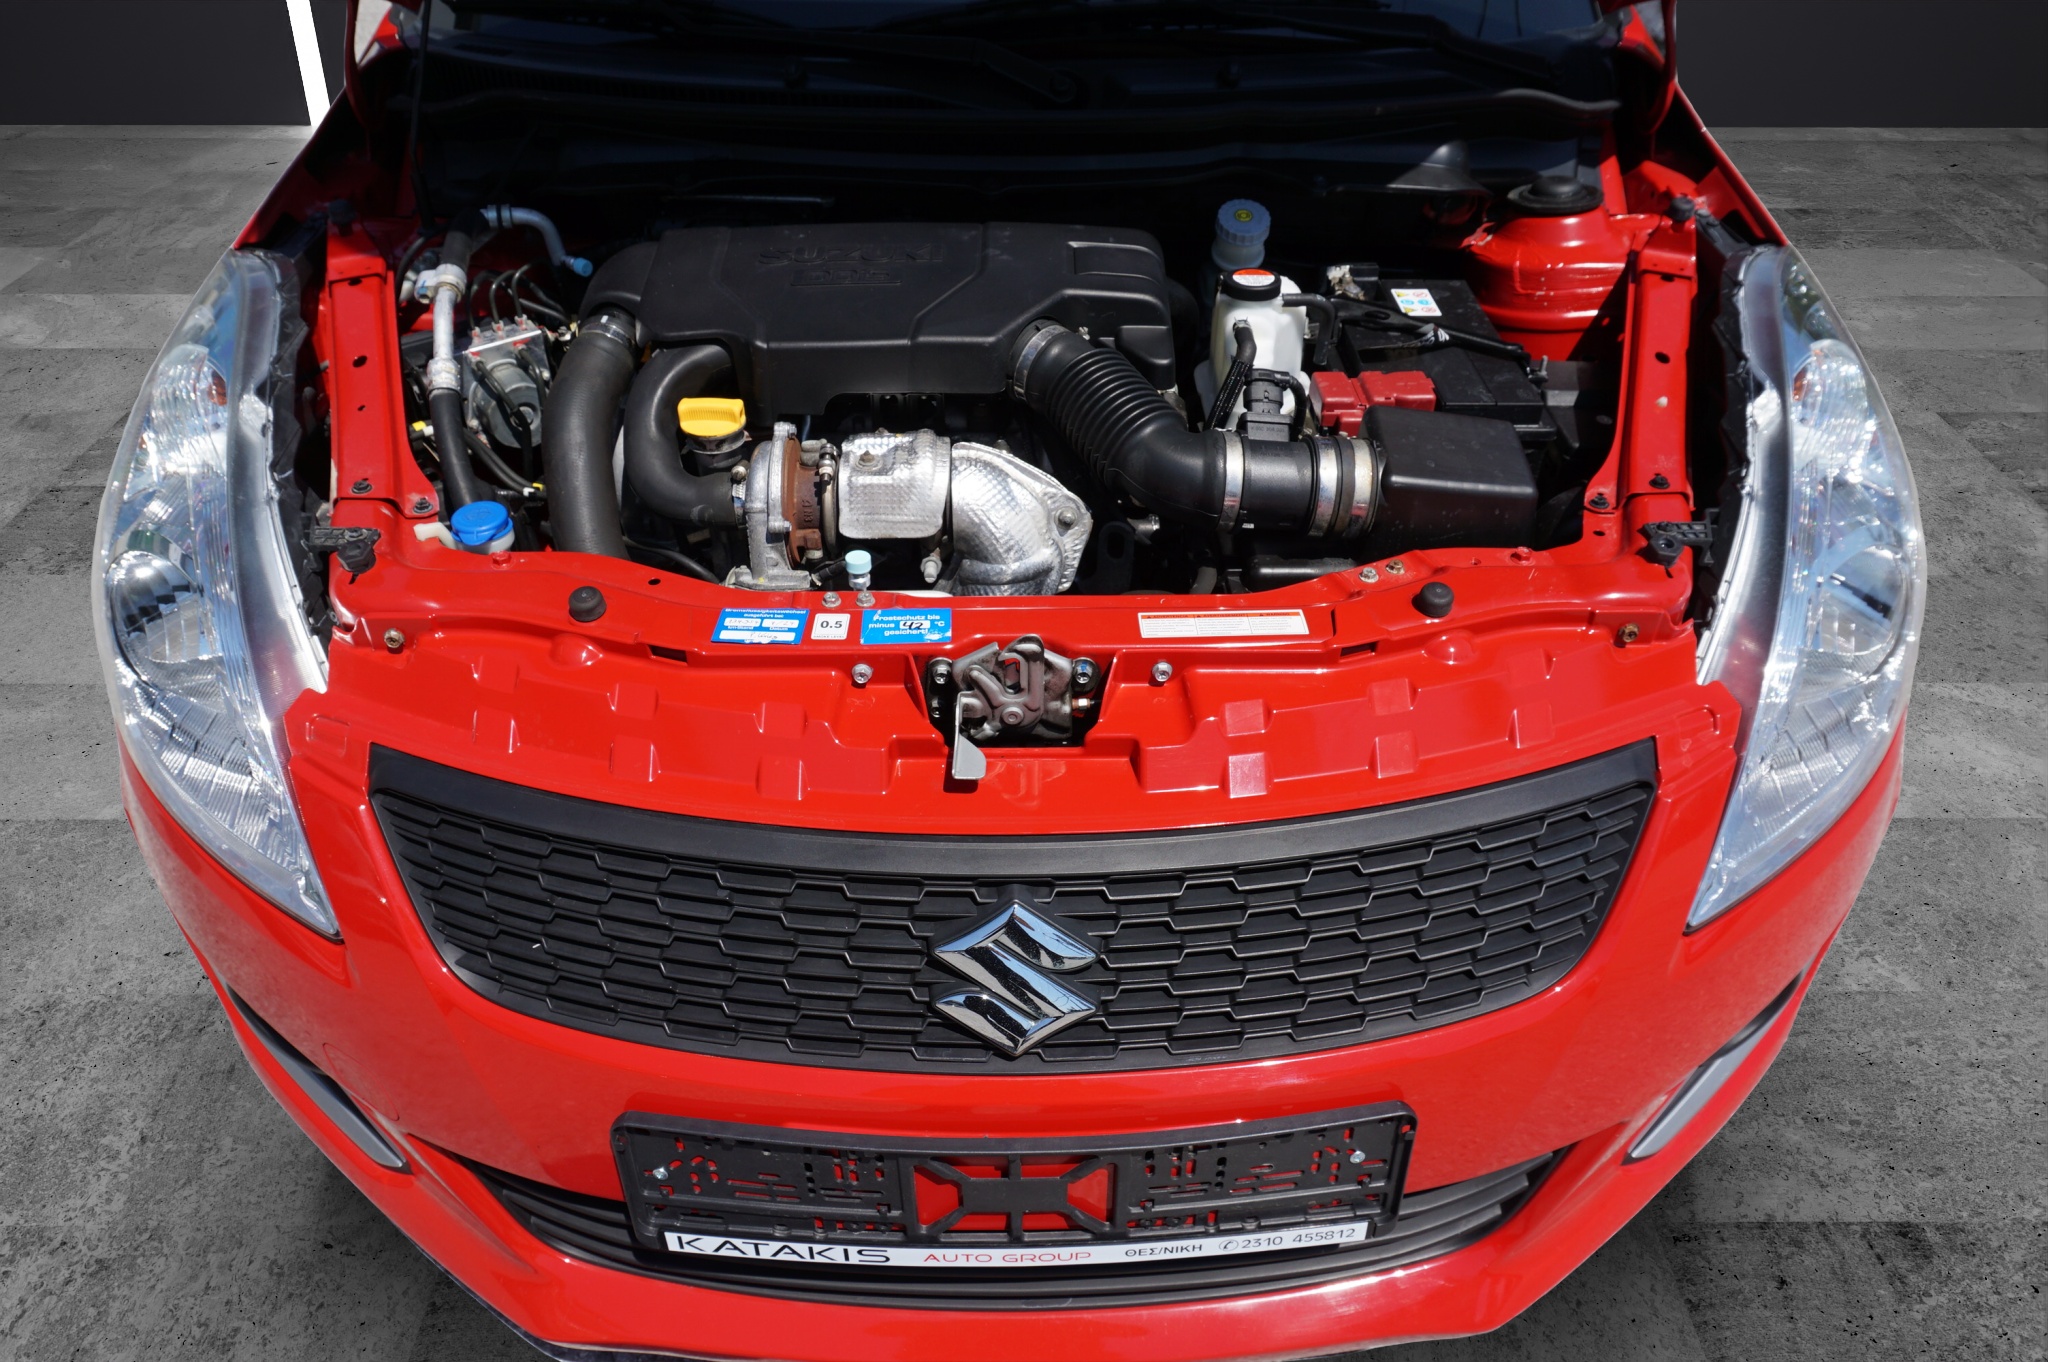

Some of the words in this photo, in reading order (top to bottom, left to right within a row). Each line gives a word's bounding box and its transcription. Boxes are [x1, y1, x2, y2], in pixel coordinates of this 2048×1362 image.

[820, 620, 843, 629] 0.5
[902, 621, 924, 630] 42
[1292, 1228, 1356, 1243] 455812
[676, 1235, 891, 1263] KATAKIS
[923, 1253, 992, 1263] AUTO
[1002, 1251, 1091, 1263] GROUP
